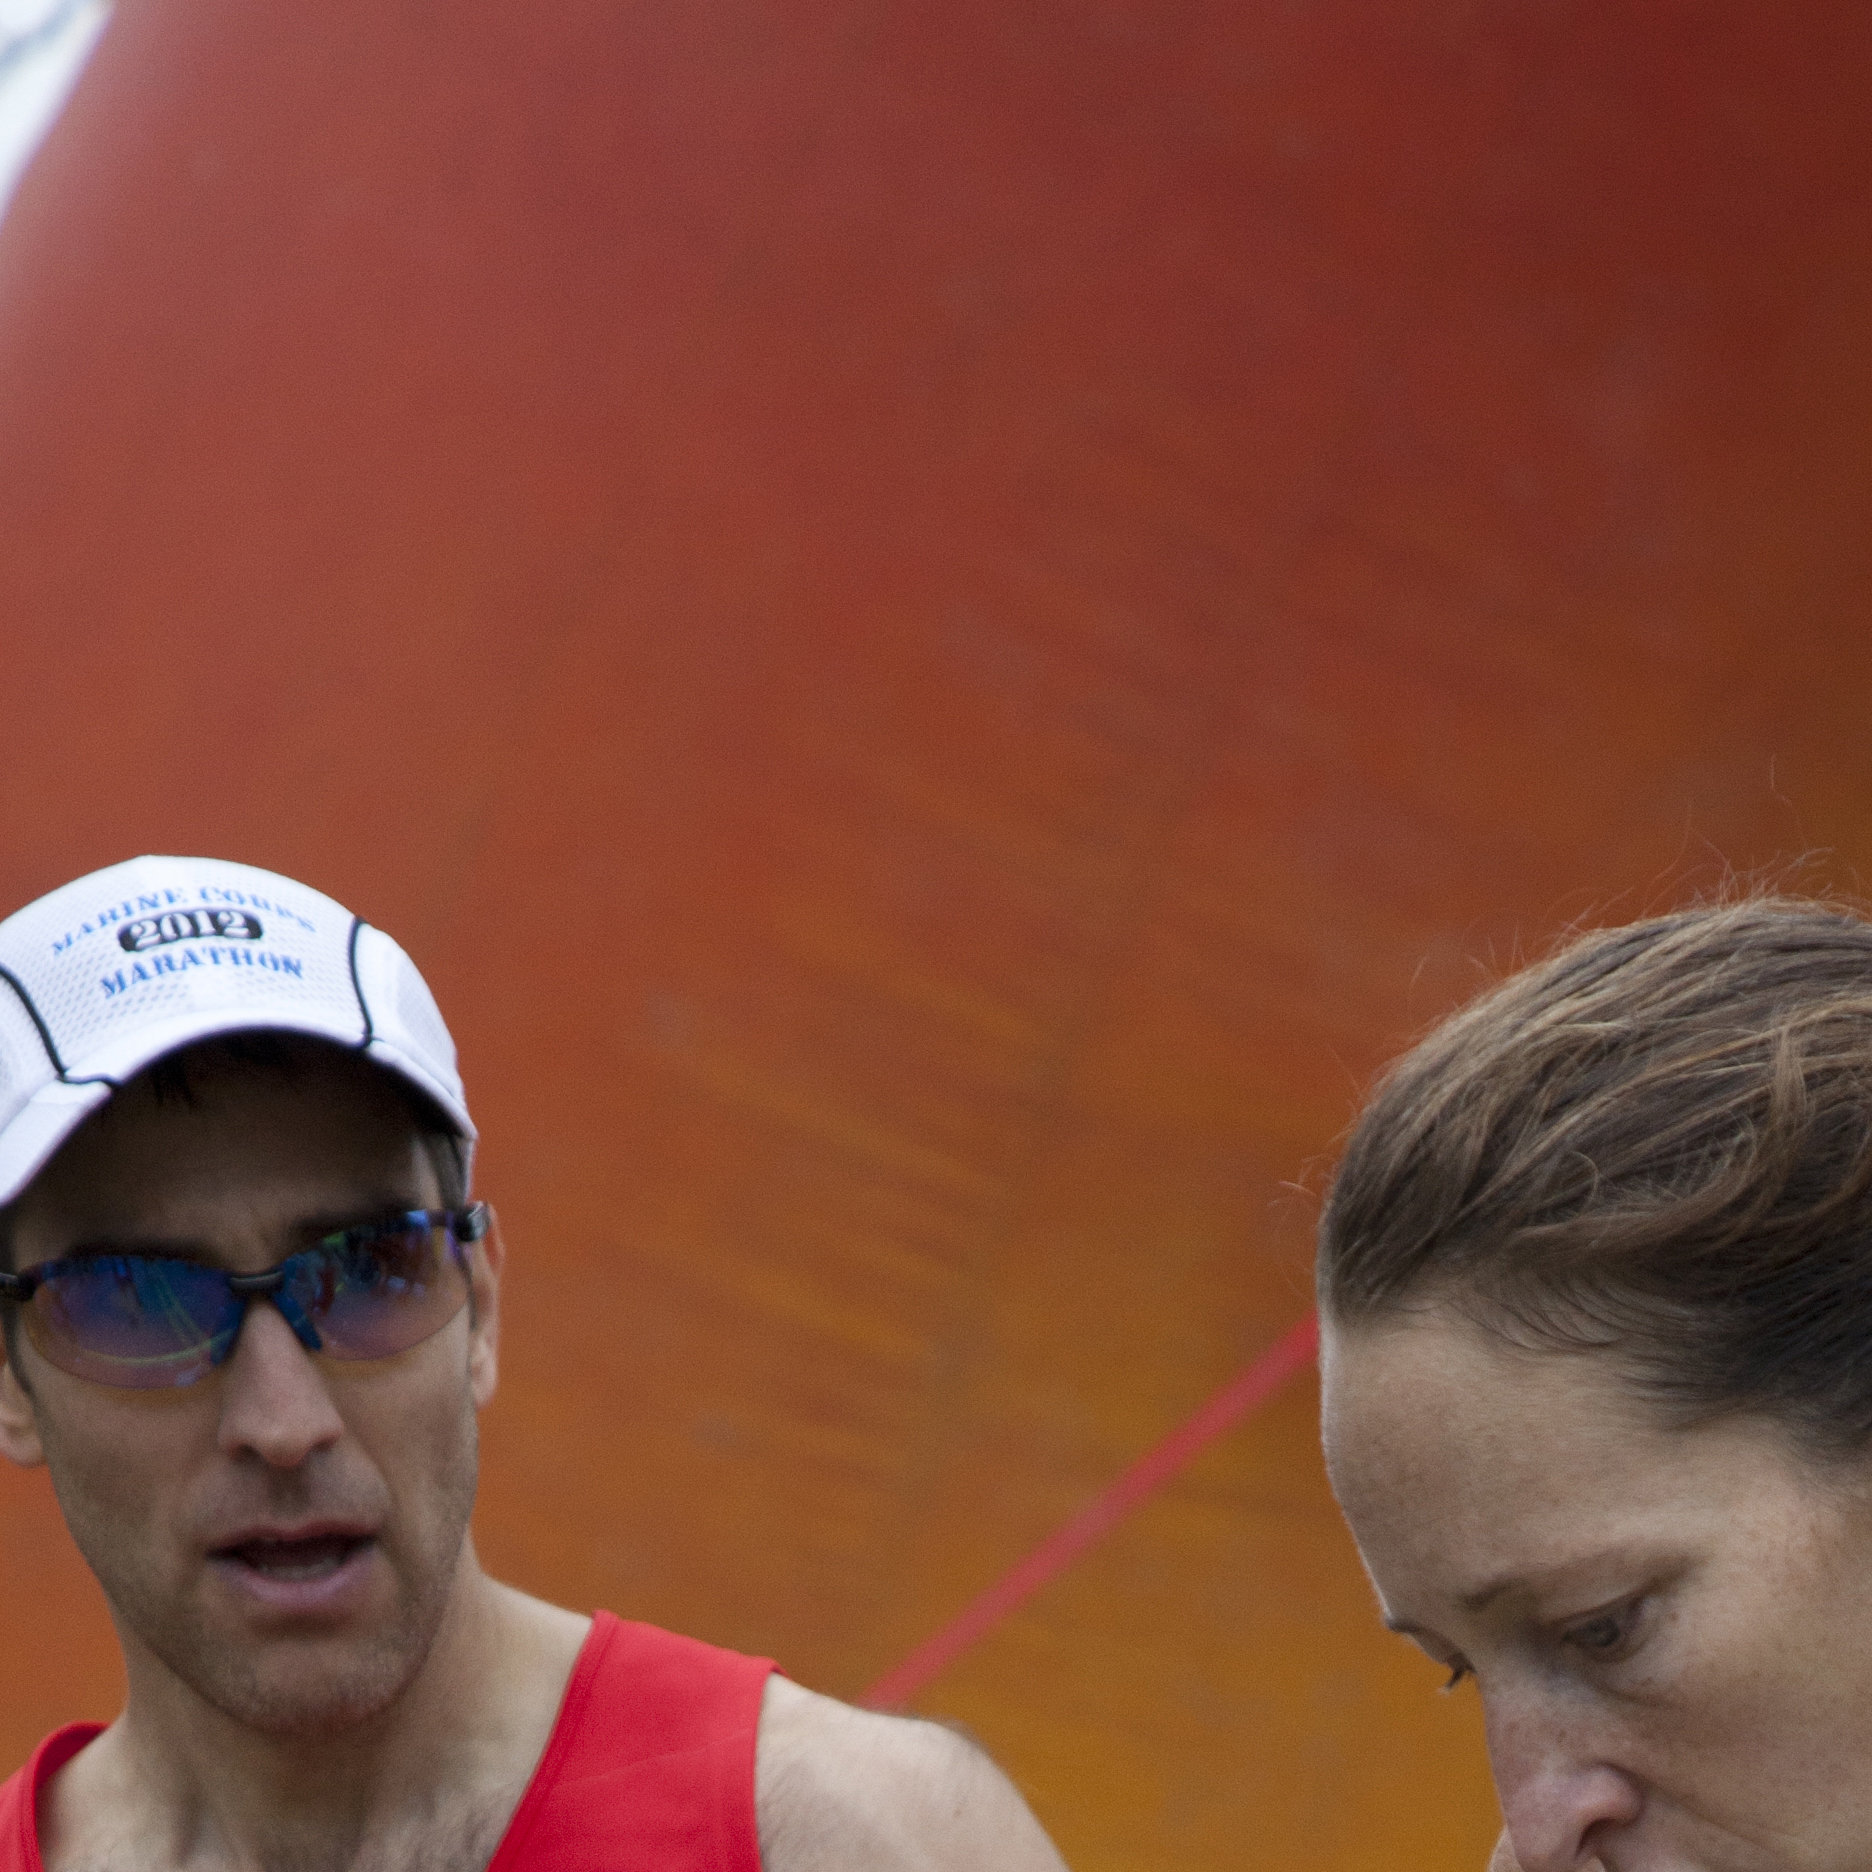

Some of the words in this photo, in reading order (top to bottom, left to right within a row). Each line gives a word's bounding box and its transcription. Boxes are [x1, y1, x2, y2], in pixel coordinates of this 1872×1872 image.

[52, 888, 188, 956] MARINE
[129, 909, 252, 951] 2012
[100, 946, 303, 999] MARATHON
